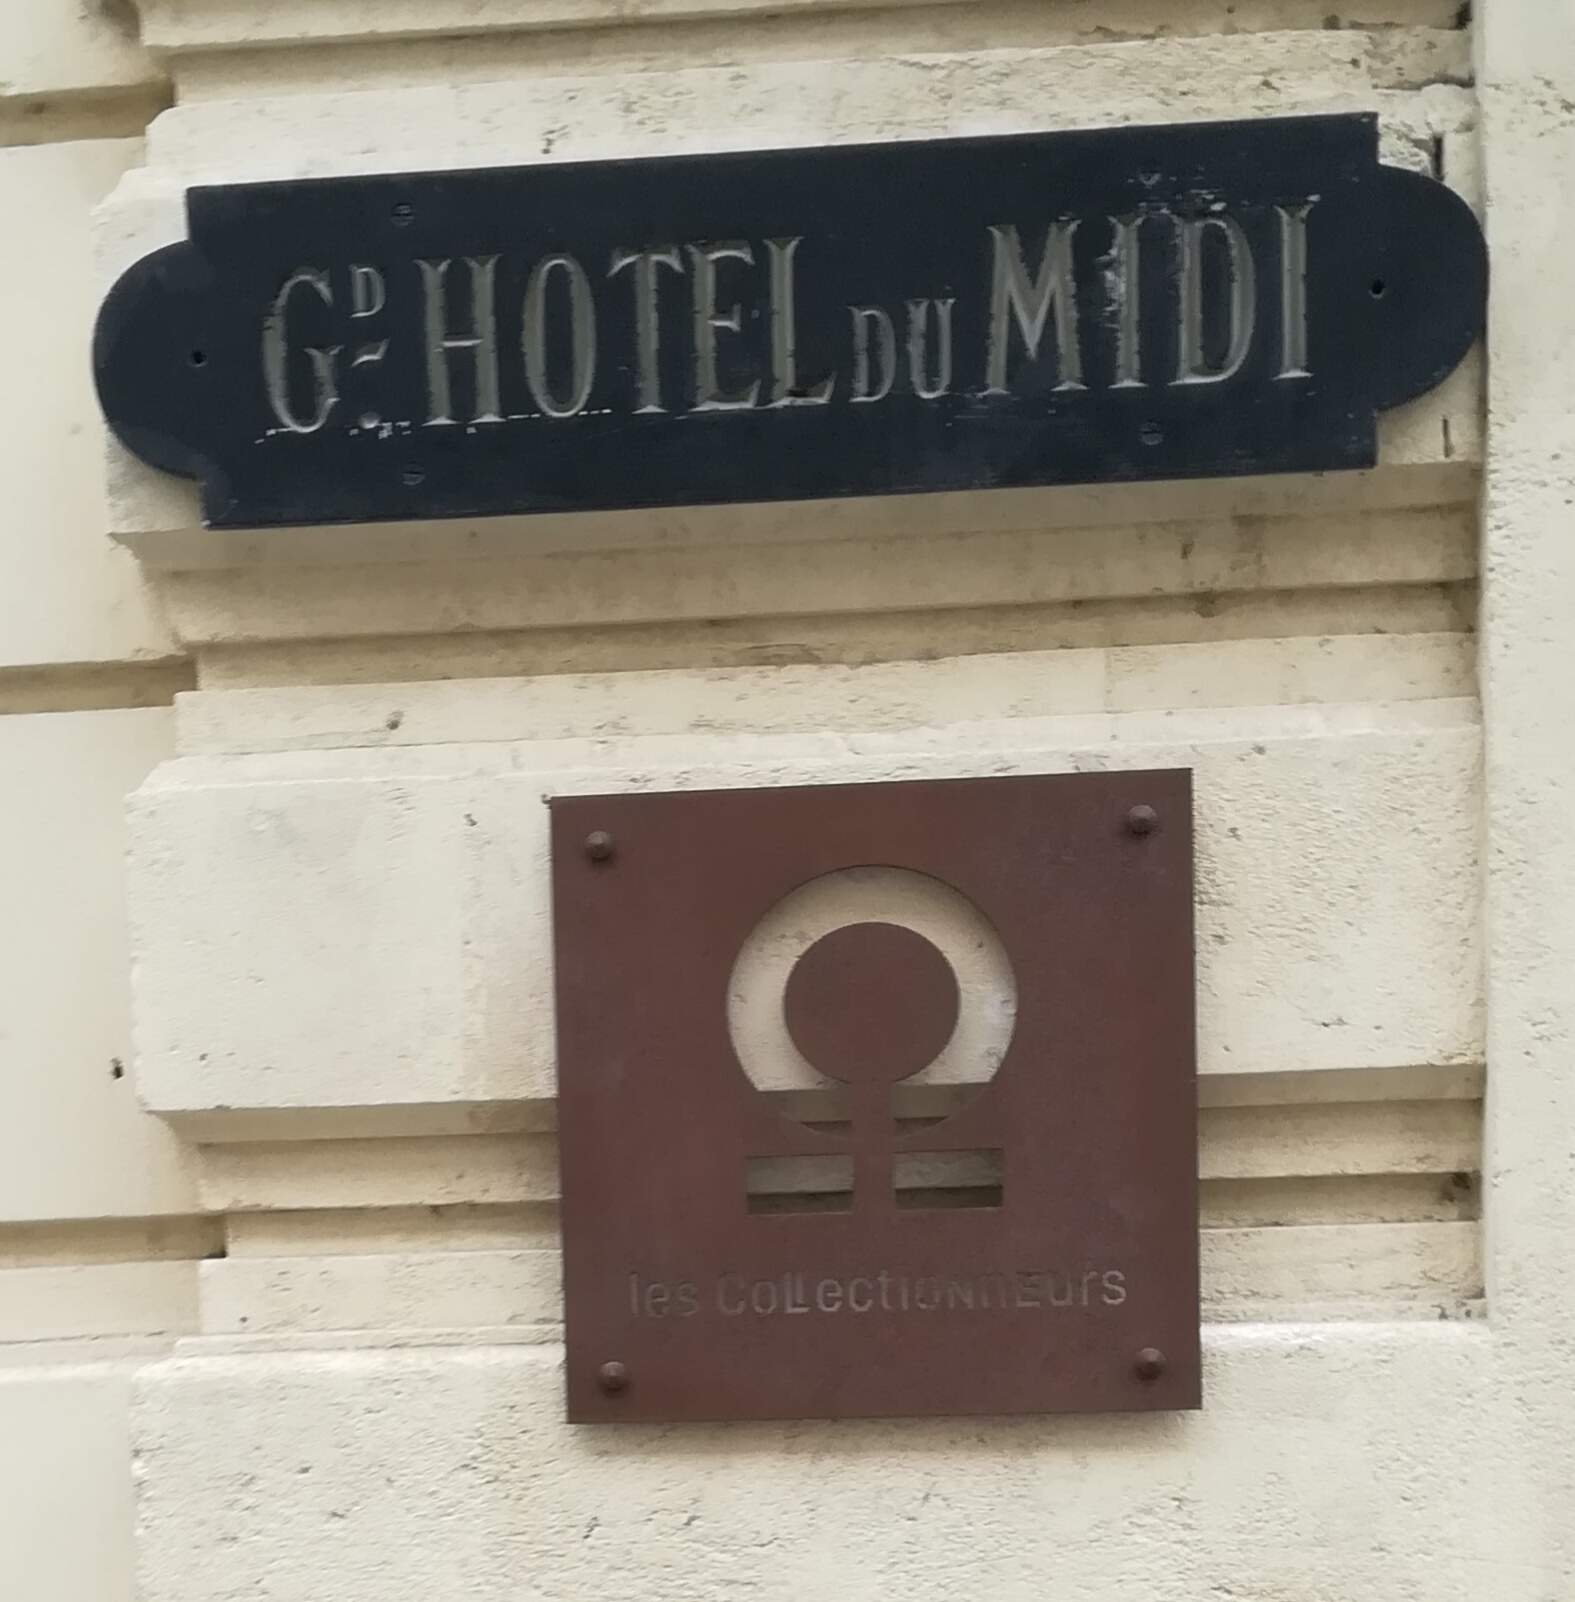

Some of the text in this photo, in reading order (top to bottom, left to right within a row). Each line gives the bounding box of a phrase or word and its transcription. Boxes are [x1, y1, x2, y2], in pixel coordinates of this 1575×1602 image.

[413, 236, 836, 426] HOTEL
[848, 297, 956, 402] DU
[978, 199, 1315, 397] MIDI
[627, 1271, 699, 1319] les
